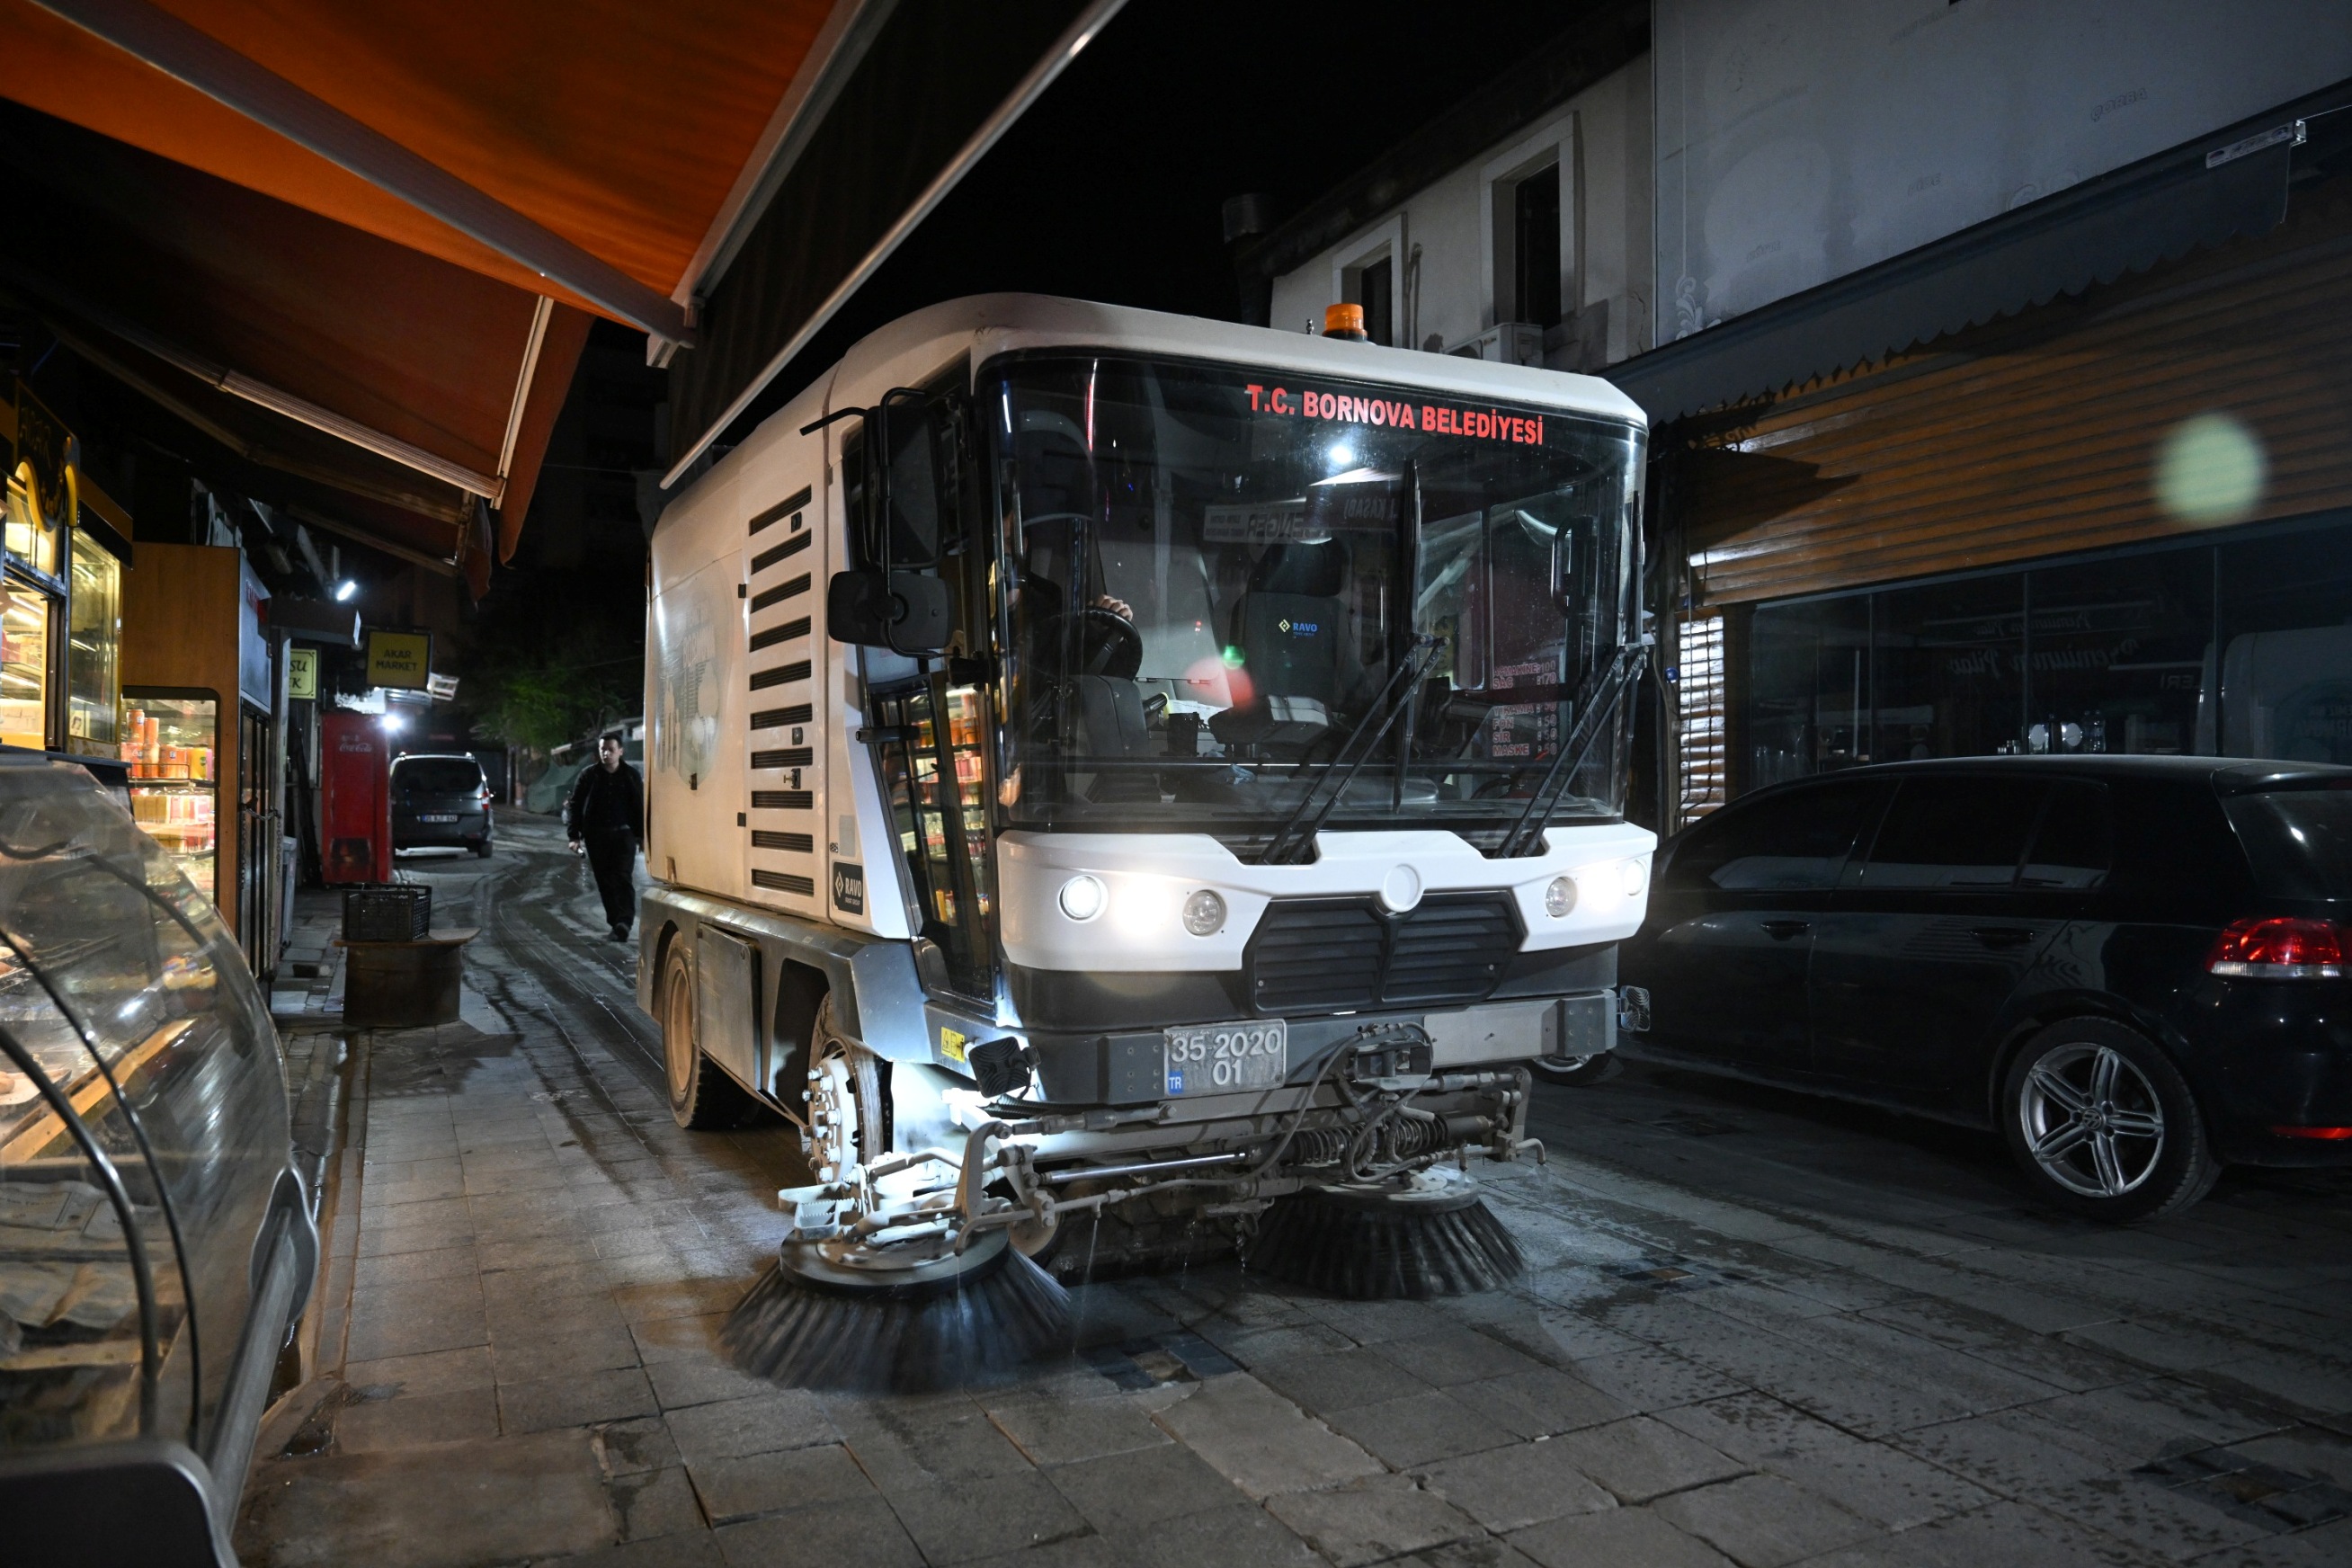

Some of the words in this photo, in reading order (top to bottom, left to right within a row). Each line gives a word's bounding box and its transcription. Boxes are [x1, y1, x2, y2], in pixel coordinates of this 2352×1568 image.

[1244, 383, 1296, 415] T.C.
[1303, 390, 1416, 430] BORNOVA
[1421, 405, 1544, 446] BELEDİYESİ
[1293, 622, 1318, 632] RAVO
[383, 649, 412, 659] AKAR
[290, 660, 307, 673] SU
[376, 660, 418, 672] MARKET
[1492, 743, 1530, 757] MASKE
[845, 878, 861, 897] RAVO
[1213, 1059, 1243, 1085] 01
[1169, 1076, 1181, 1090] TR
